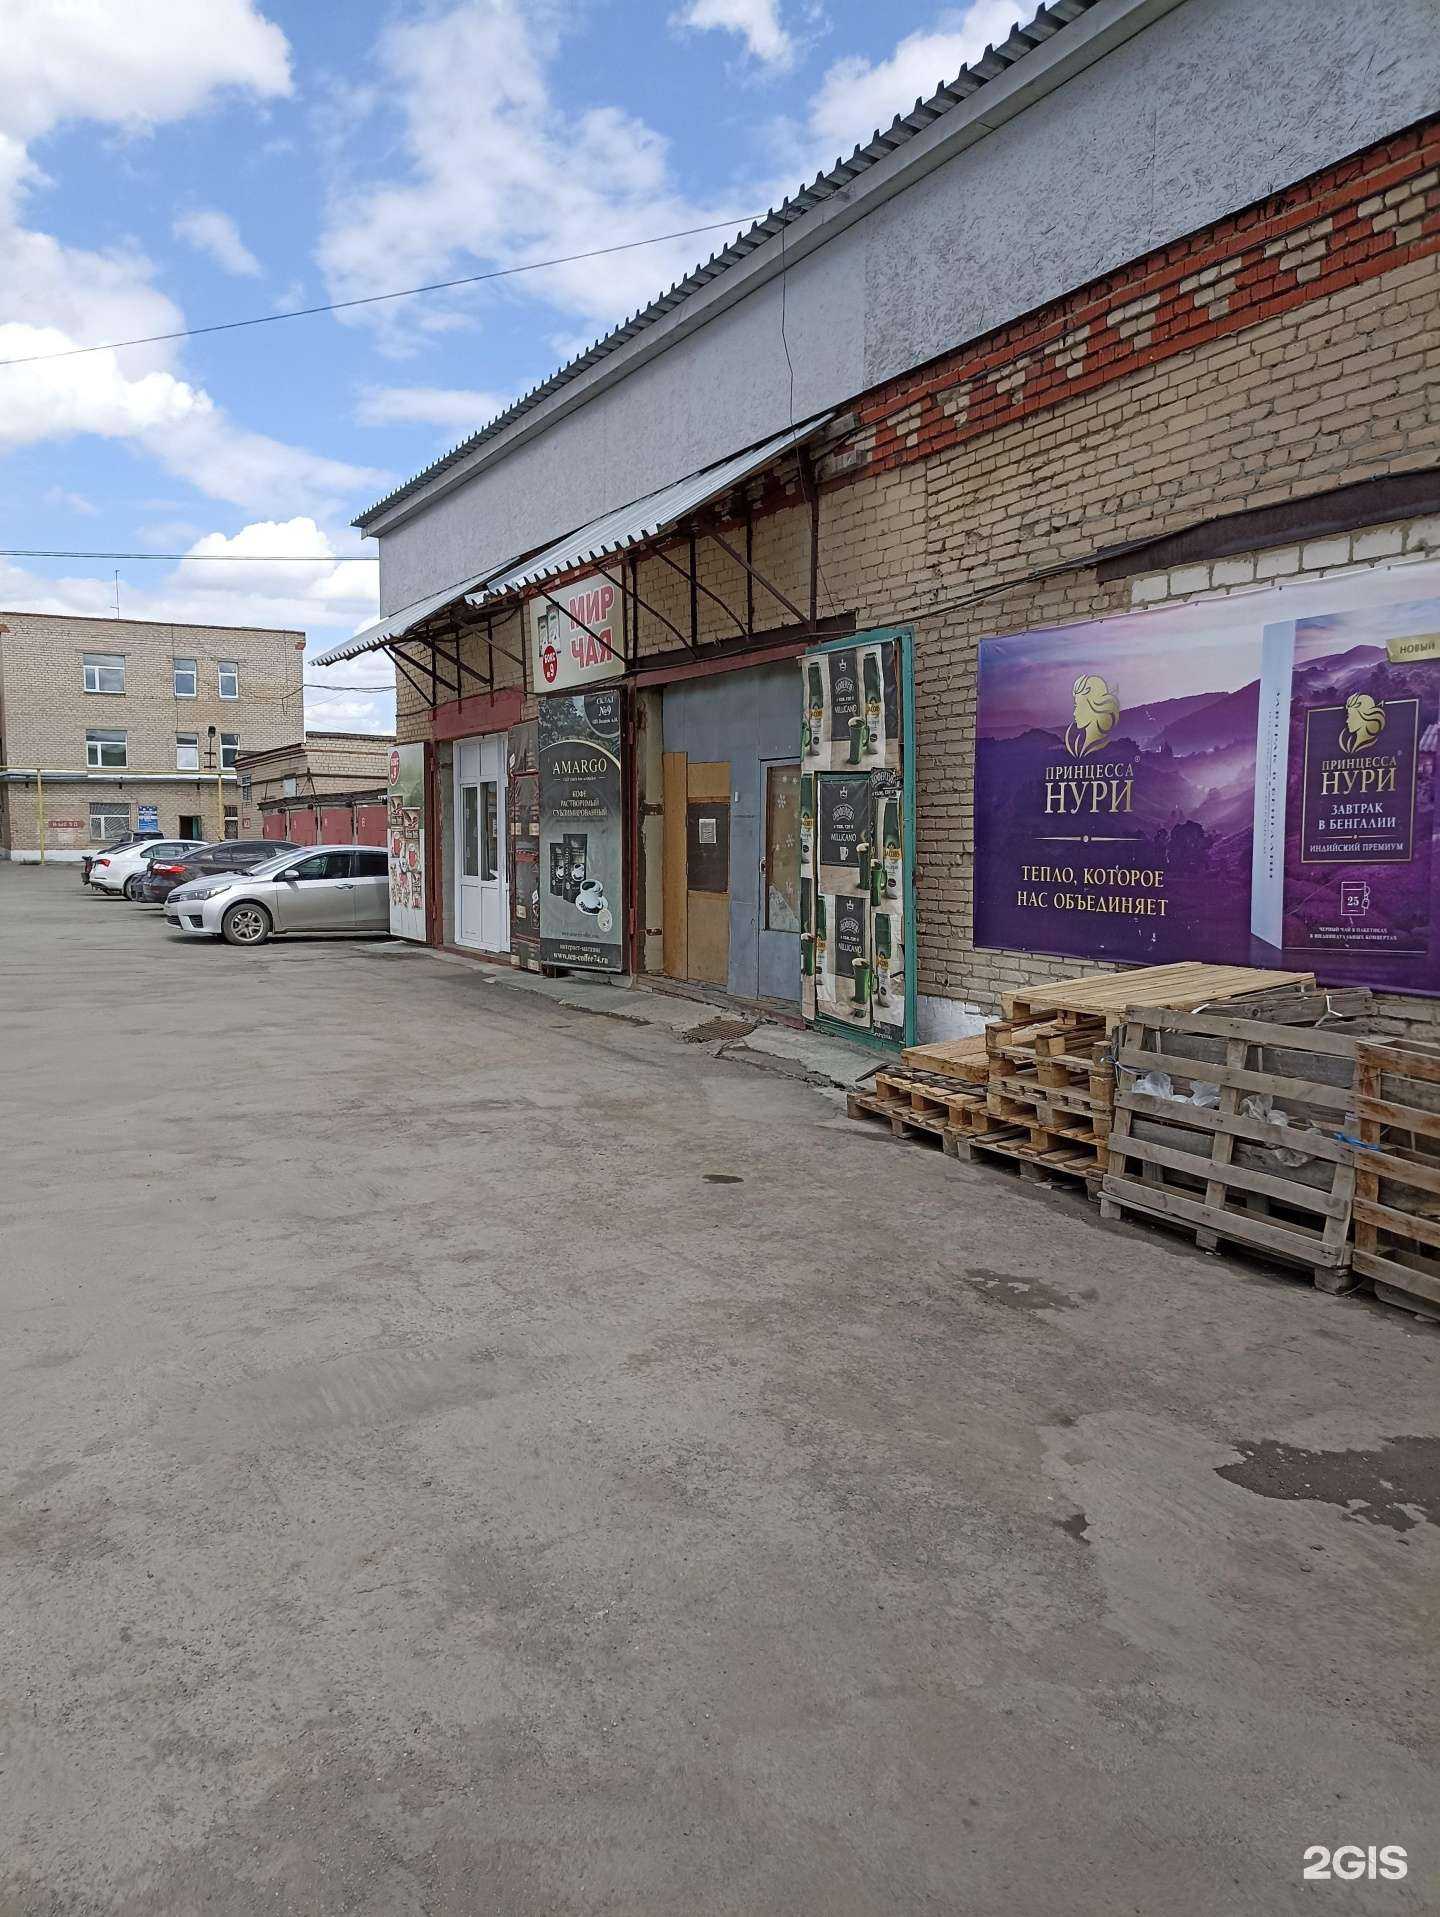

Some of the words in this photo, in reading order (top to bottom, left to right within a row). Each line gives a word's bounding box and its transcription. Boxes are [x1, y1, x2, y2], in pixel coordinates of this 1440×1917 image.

[569, 584, 615, 631] МИР
[570, 626, 613, 670] ЧАЯ
[1400, 640, 1436, 654] НОВЫЙ
[552, 758, 608, 775] AMARGO
[1045, 763, 1134, 780] ПРИНЦЕССА
[1321, 756, 1397, 771] ПРИНЦЕССА
[1320, 767, 1397, 795] НУРИ
[1044, 779, 1135, 814] НУРИ
[1331, 802, 1383, 815] ЗАВТРАК
[1318, 819, 1326, 830] В
[1329, 817, 1396, 830] БЕНГАЛИИ
[1310, 843, 1360, 853] ИНДИЙСКИЙ
[1362, 843, 1404, 852] ПРЕМИУМ
[1021, 865, 1078, 886] ТЕПЛО,
[1083, 867, 1165, 888] КОТОРОЕ
[1017, 891, 1048, 908] НАС
[1053, 892, 1169, 916] ОБЪЕДИНЯЕТ
[1347, 895, 1360, 906] 25
